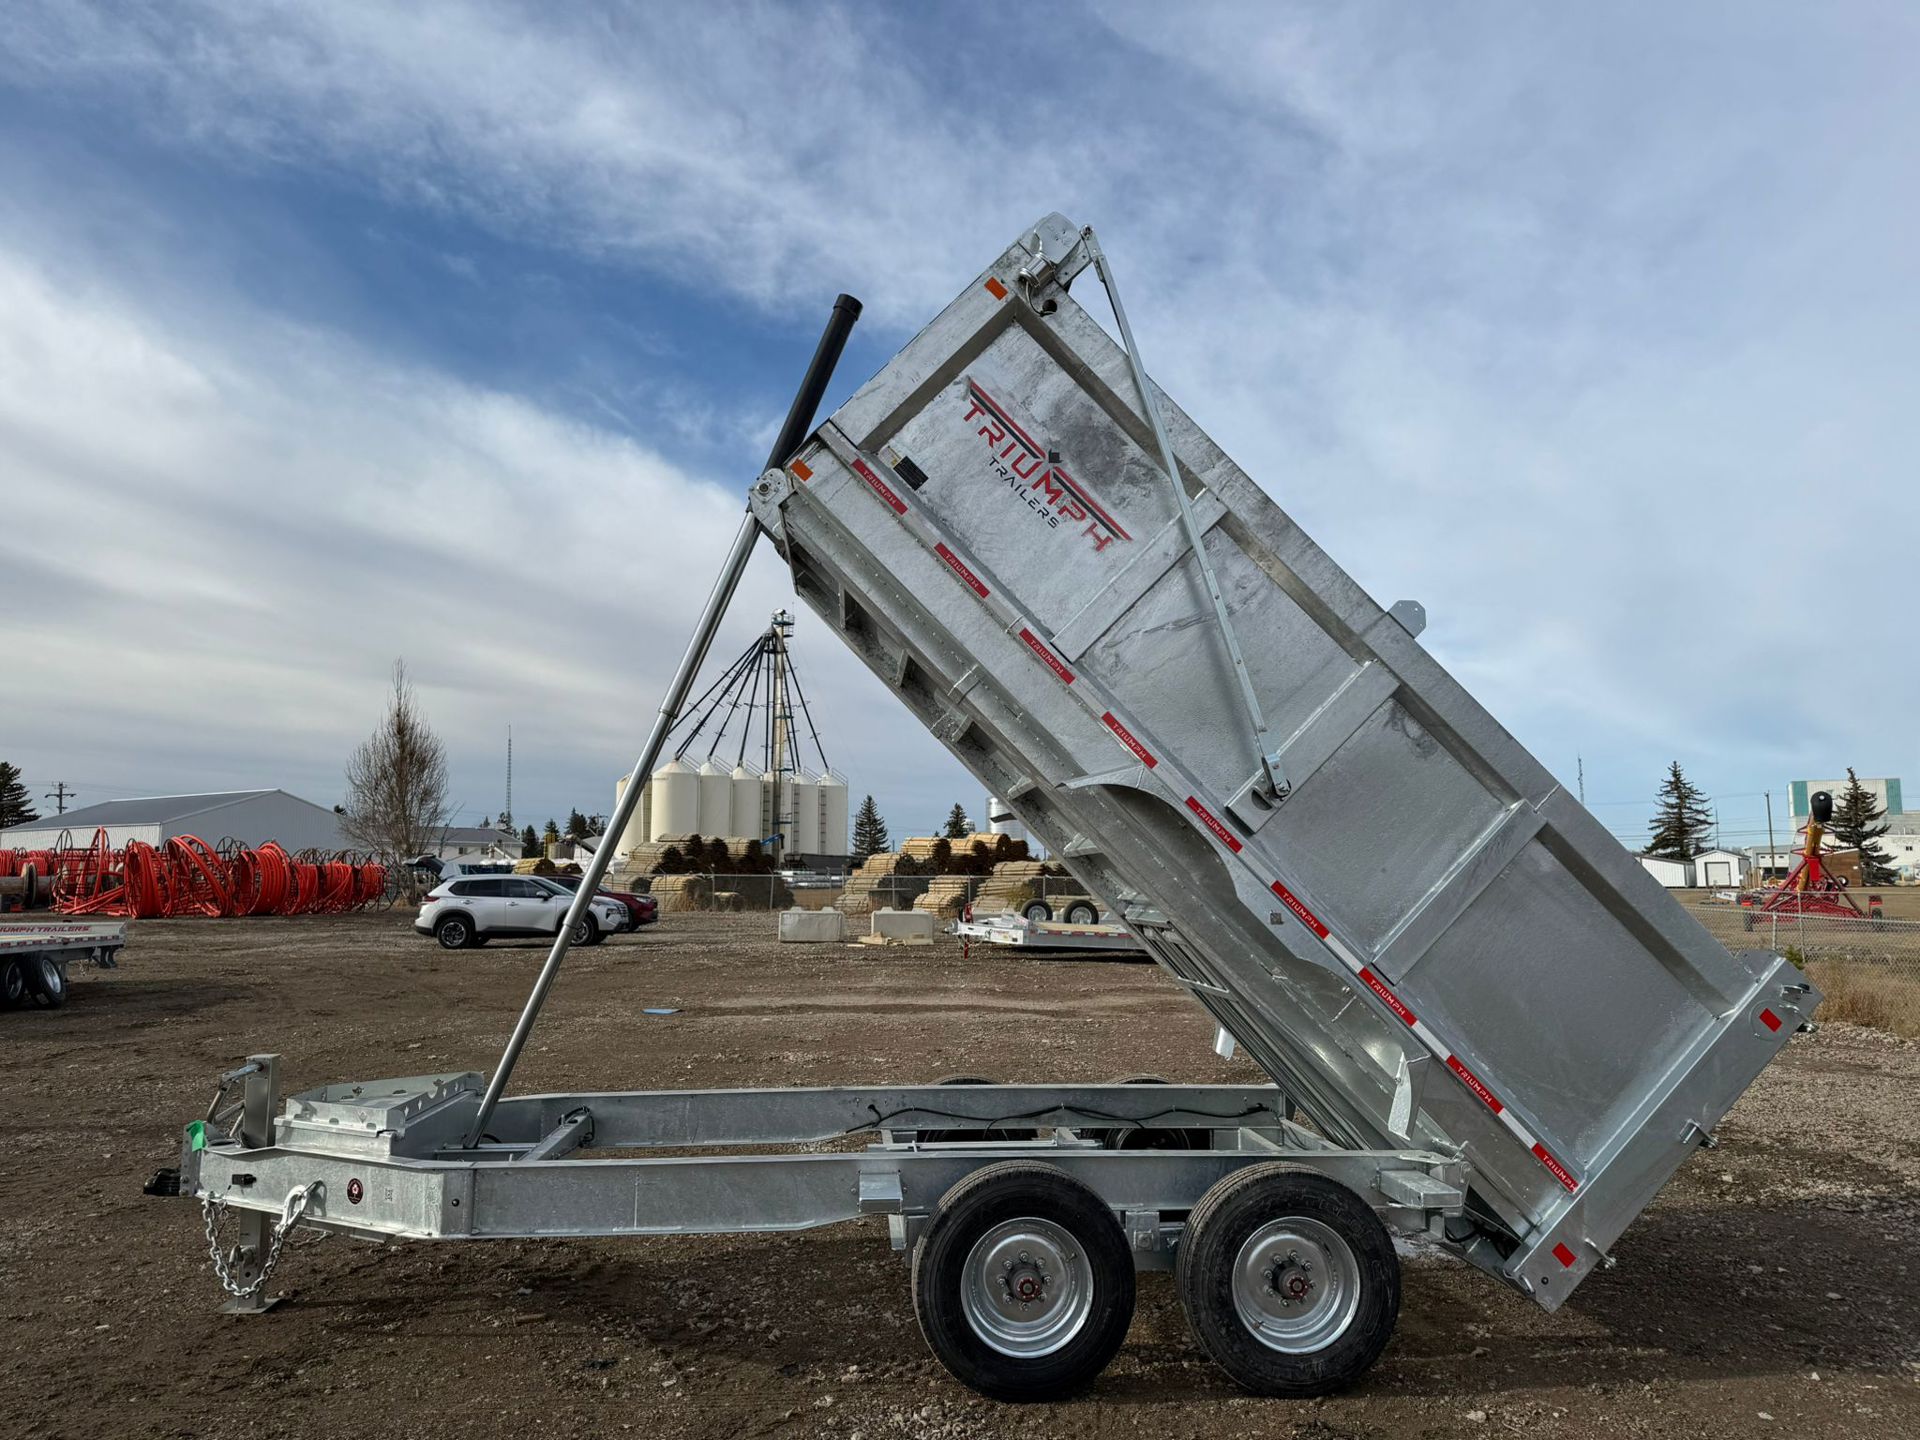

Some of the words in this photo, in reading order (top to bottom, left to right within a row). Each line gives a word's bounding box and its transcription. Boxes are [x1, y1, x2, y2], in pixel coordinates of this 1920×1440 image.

[863, 470, 897, 505] TRIUMPH
[963, 398, 1113, 552] TRIUMPH
[989, 456, 1059, 529] TRAILERS
[945, 553, 979, 588] TRIUMPH
[1030, 640, 1064, 674] TRIUMPH
[1112, 723, 1146, 759] TRIUMPH
[1197, 807, 1231, 843] TRIUMPH
[1283, 892, 1318, 929] TRIUMPH
[1370, 979, 1405, 1016] TRIUMPH
[1456, 1066, 1492, 1103] TRIUMPH
[1543, 1155, 1577, 1192] TRIUMPH
